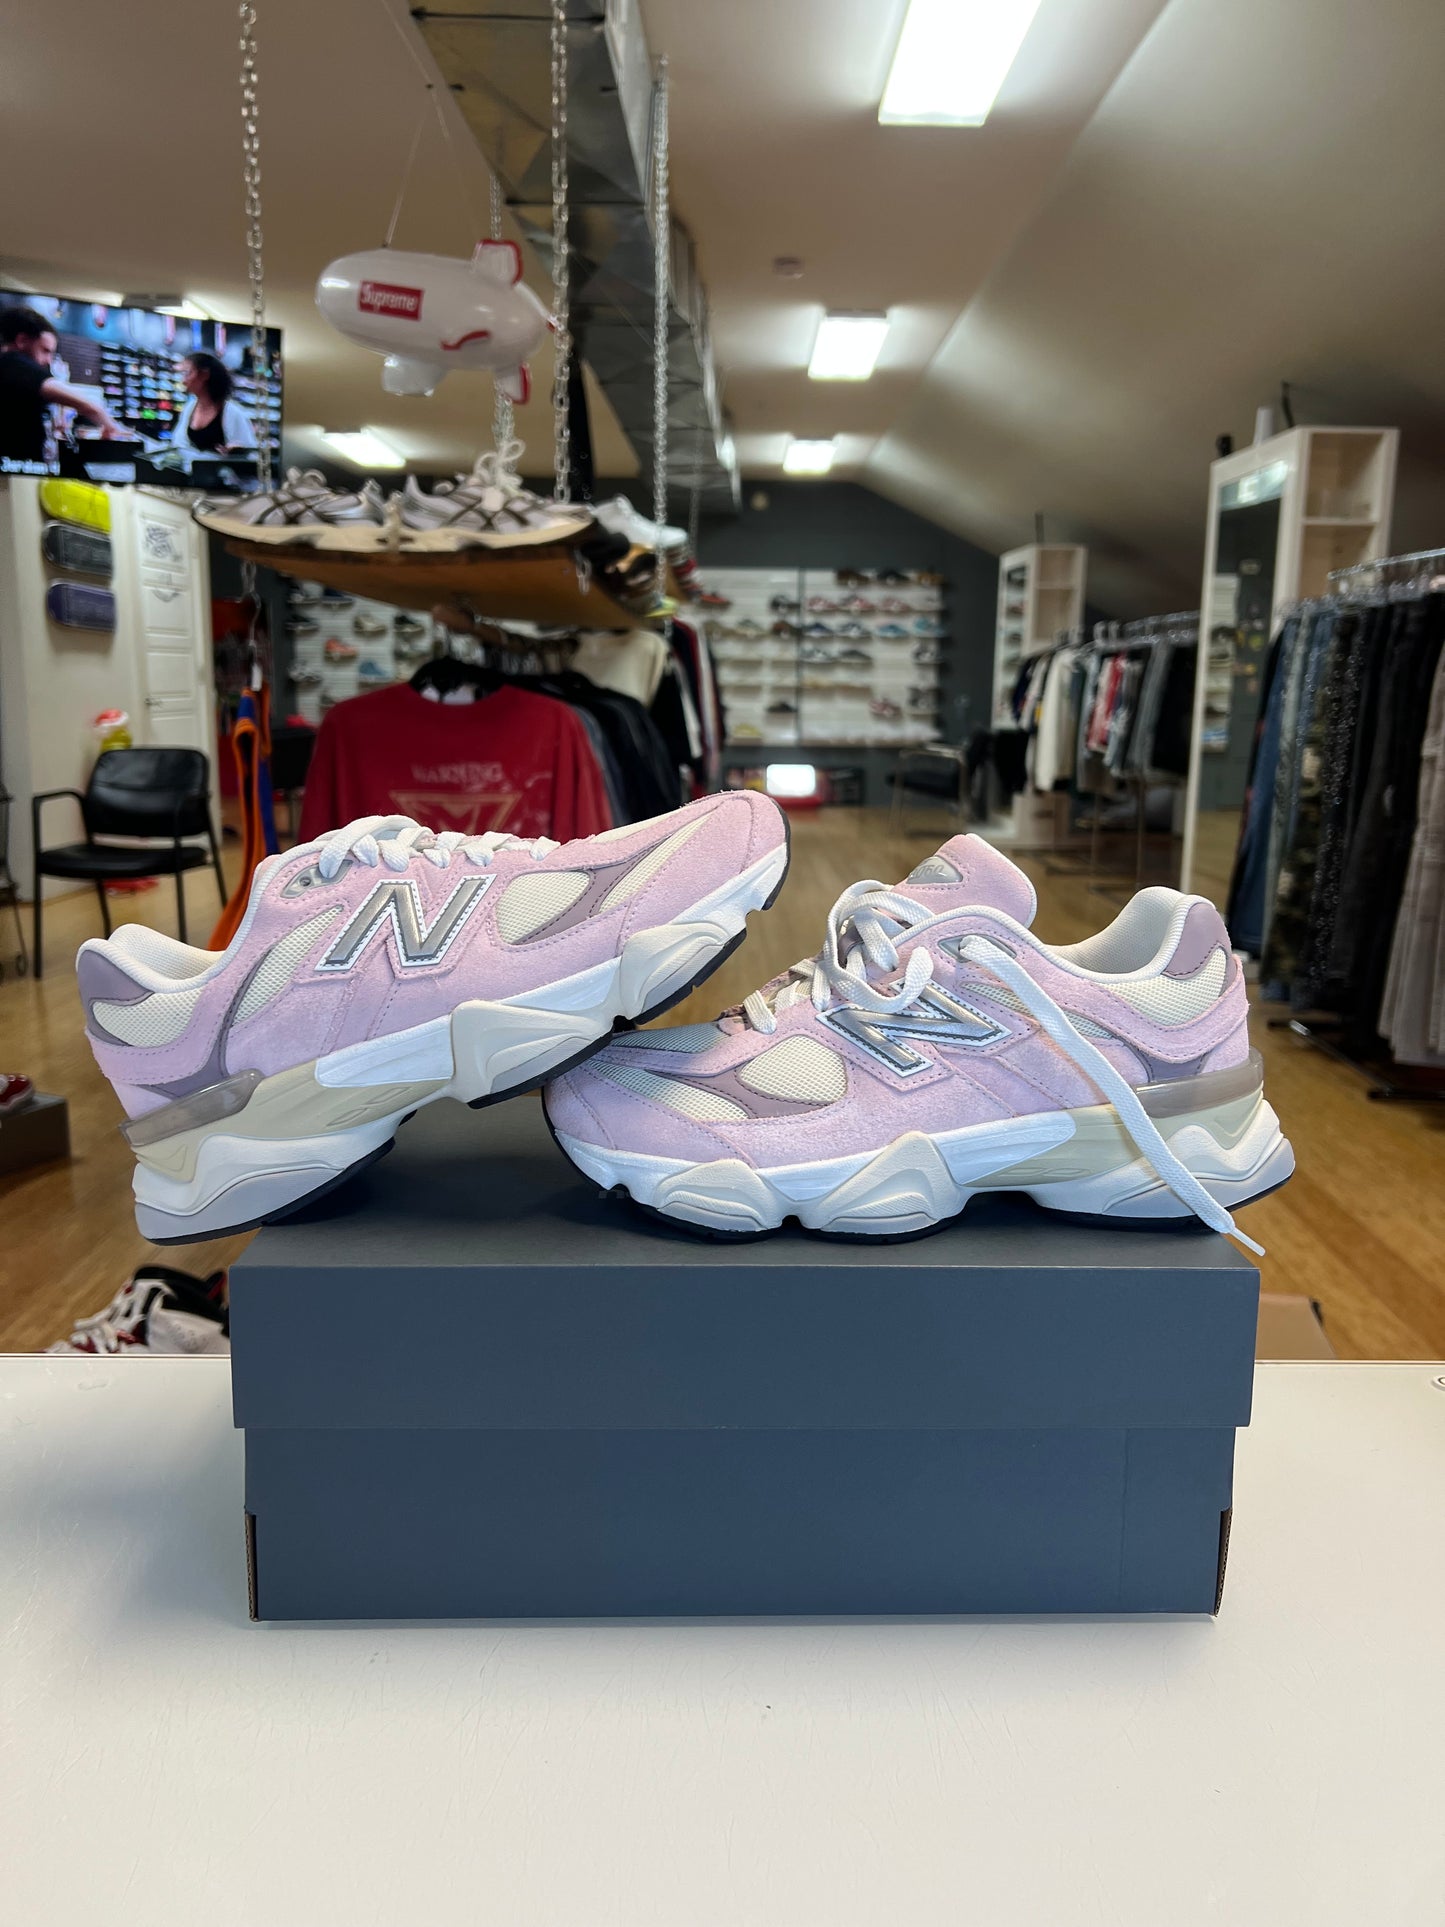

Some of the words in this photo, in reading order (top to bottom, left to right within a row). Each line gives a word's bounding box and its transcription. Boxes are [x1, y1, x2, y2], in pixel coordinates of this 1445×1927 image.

[361, 283, 418, 313] Supreme
[410, 761, 503, 785] WARNING
[314, 874, 497, 971] N
[815, 978, 1012, 1077] N
